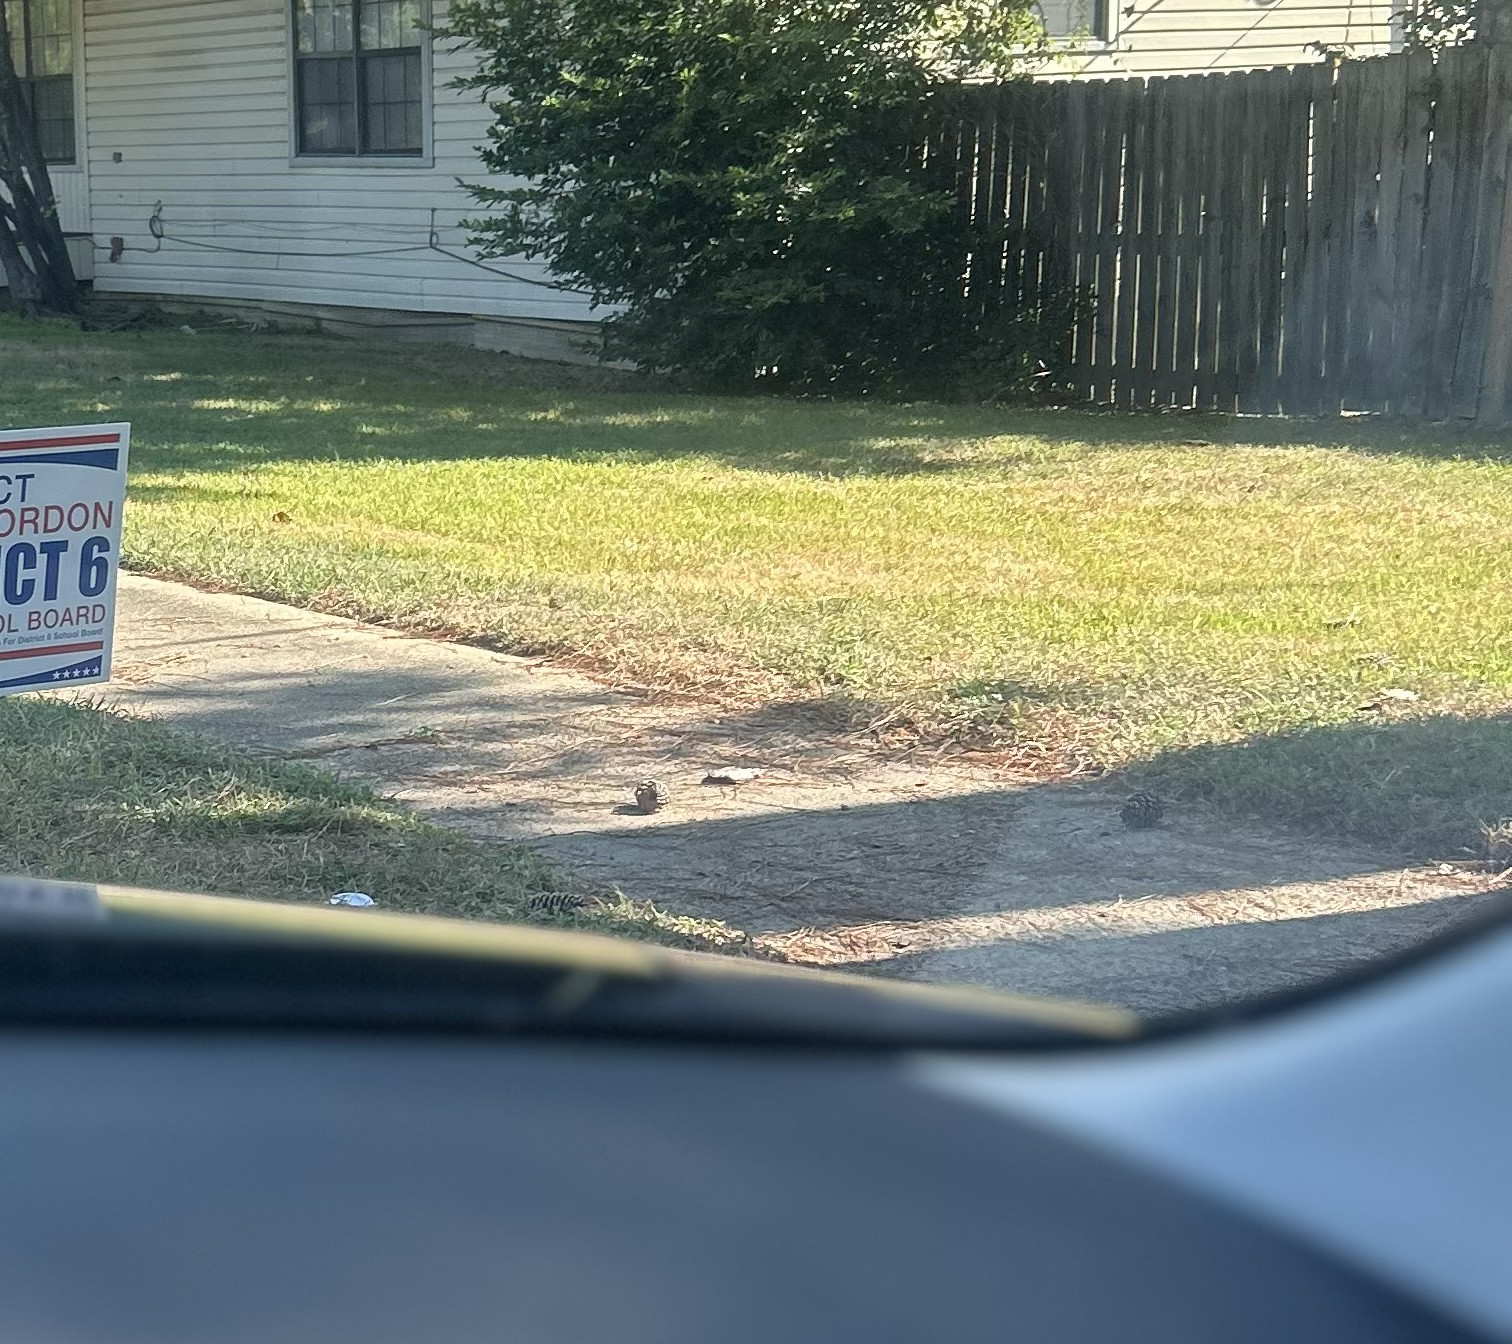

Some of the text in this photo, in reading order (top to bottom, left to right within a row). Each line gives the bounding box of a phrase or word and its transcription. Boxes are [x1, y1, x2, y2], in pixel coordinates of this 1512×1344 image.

[78, 536, 110, 598] 6
[27, 603, 106, 631] BOARD
[3, 637, 16, 646] For
[18, 634, 45, 644] District
[53, 630, 79, 640] School
[81, 628, 103, 637] Board
